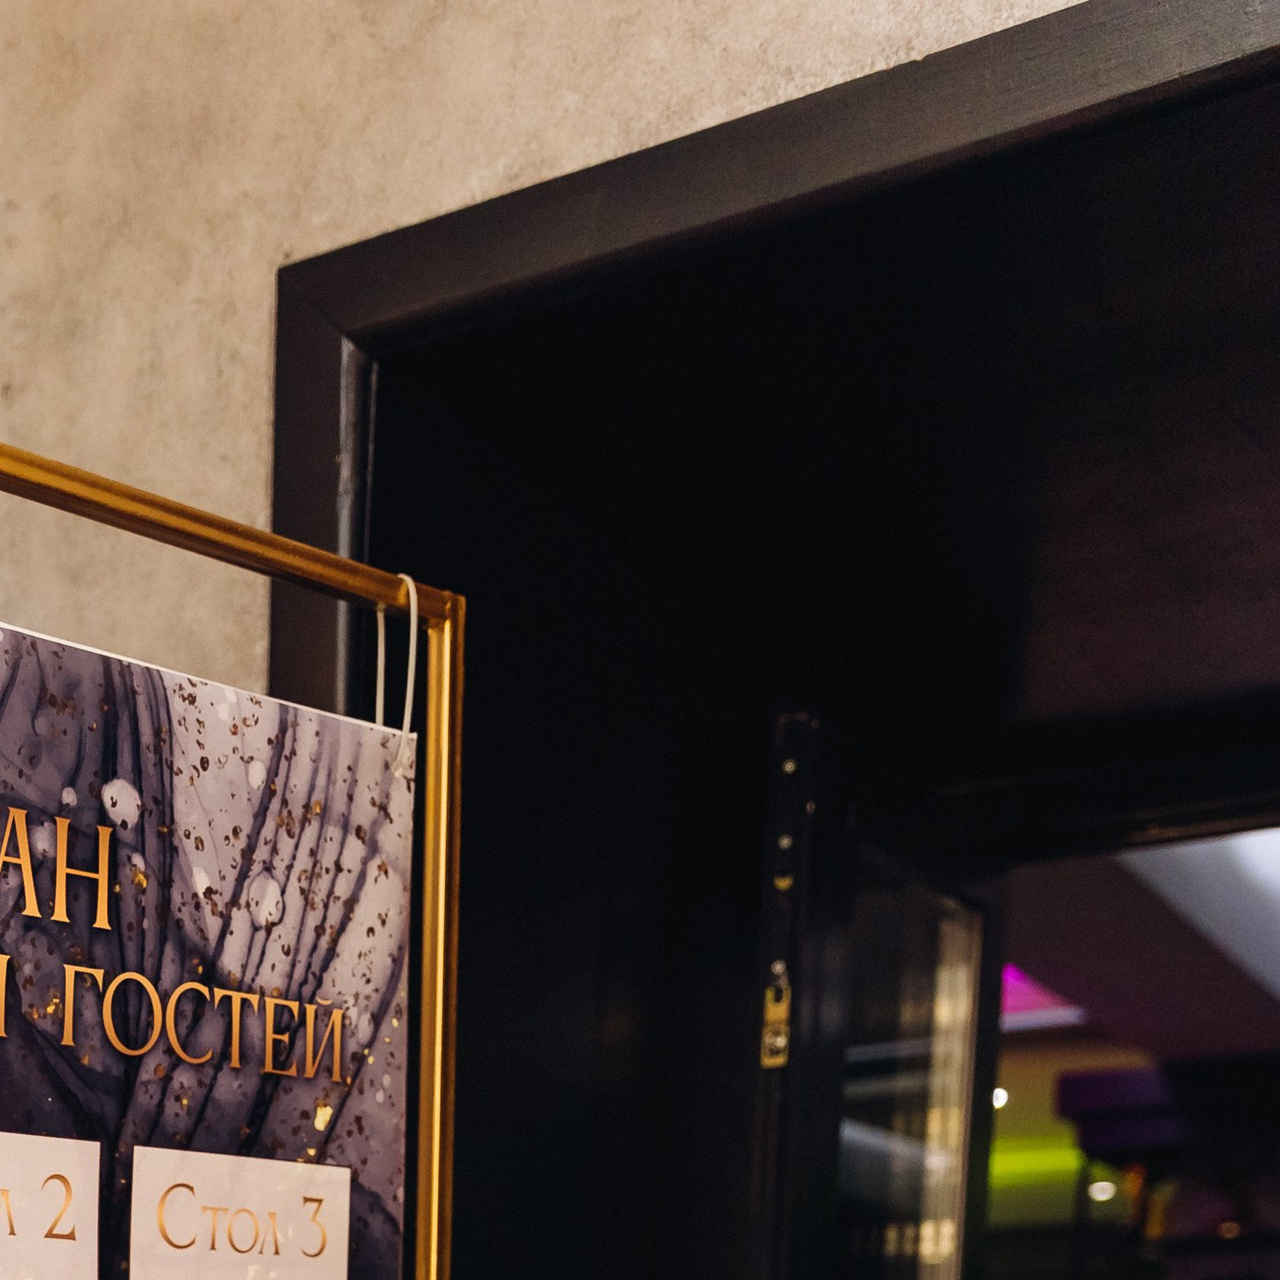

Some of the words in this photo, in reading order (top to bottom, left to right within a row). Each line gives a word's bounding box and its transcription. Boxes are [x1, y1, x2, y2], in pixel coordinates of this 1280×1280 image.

[59, 963, 350, 1085] ГОСТЕЙ
[42, 1174, 76, 1241] 2
[158, 1183, 280, 1256] Стол
[302, 1196, 326, 1258] 3
